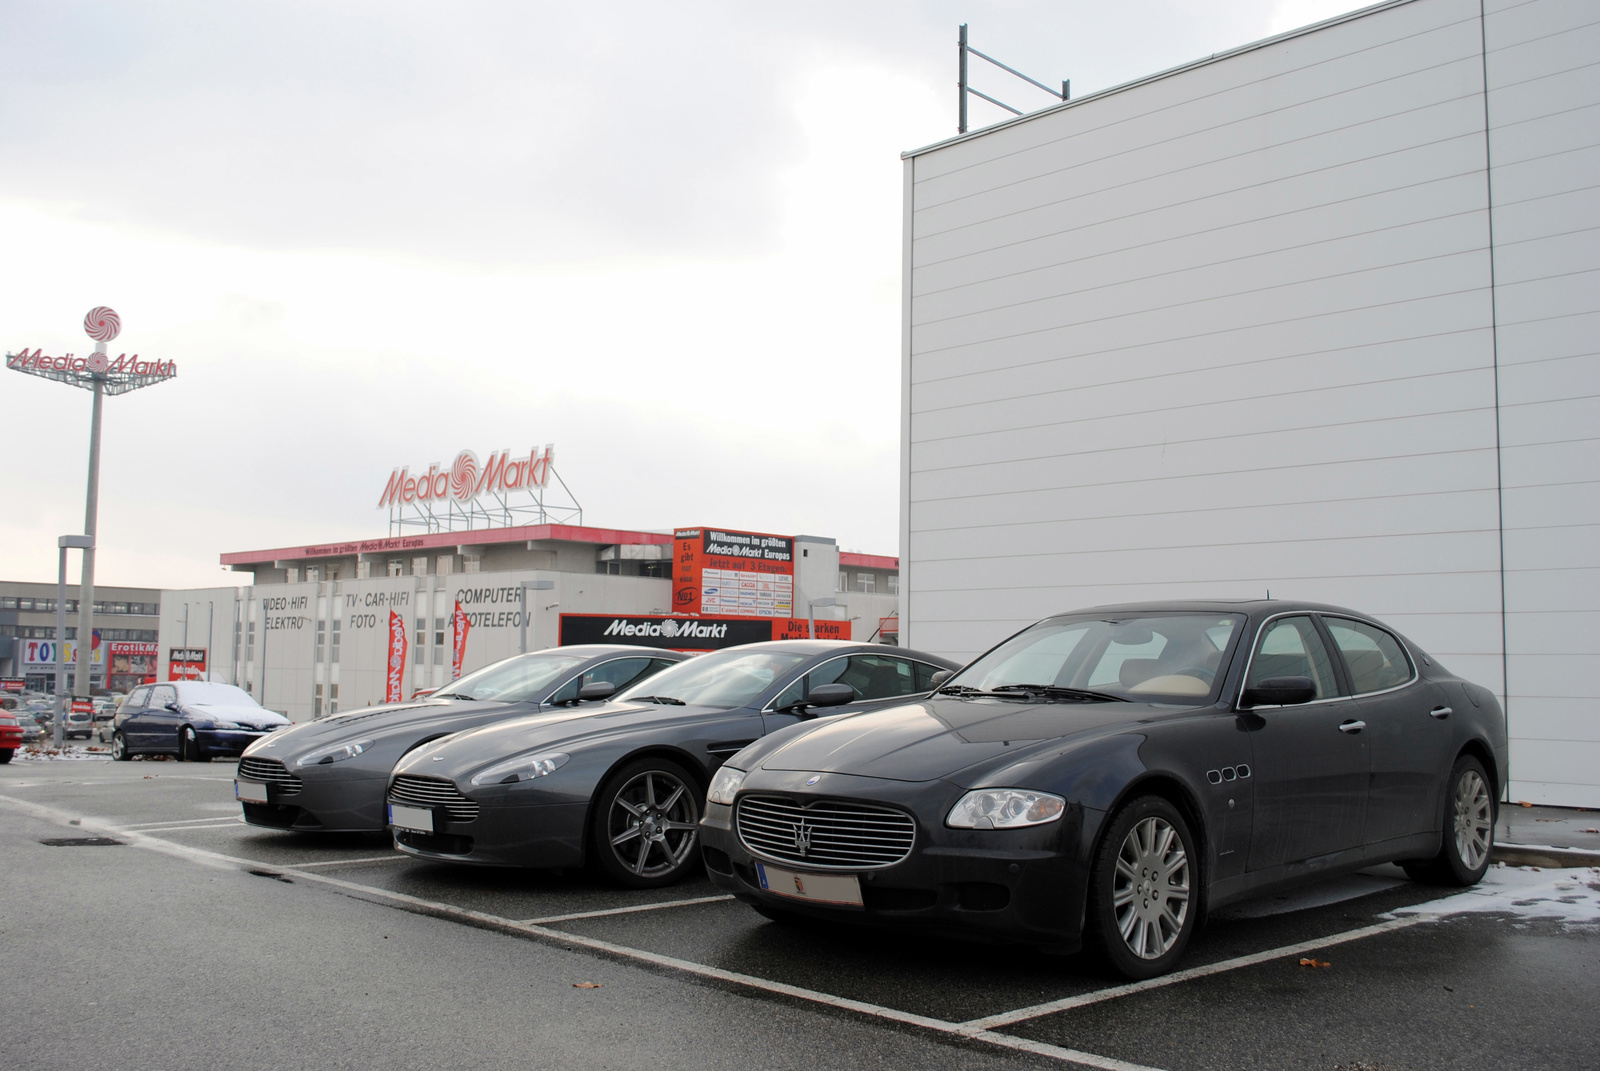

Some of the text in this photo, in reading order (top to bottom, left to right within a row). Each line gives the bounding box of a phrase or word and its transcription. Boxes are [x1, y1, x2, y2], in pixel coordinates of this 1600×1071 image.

[8, 348, 174, 376] Media Markt
[377, 446, 552, 507] Media Markt
[304, 546, 332, 556] Willkommen
[359, 542, 378, 551] Media
[383, 540, 401, 550] Markt
[402, 539, 424, 548] Europas
[683, 542, 691, 551] Es
[710, 531, 786, 548] Willkommen im größten
[681, 553, 694, 563] gibt
[706, 543, 791, 561] Media Markt Europas
[709, 557, 788, 574] Jetzt auf 3 Etagen.
[346, 592, 410, 607] TV CAR-HIFI
[456, 587, 522, 604] COMPUTER
[350, 614, 376, 628] FOTO
[448, 611, 532, 628] AOTELEFO
[788, 621, 840, 635] Die sarken
[603, 619, 728, 639] Media Markt
